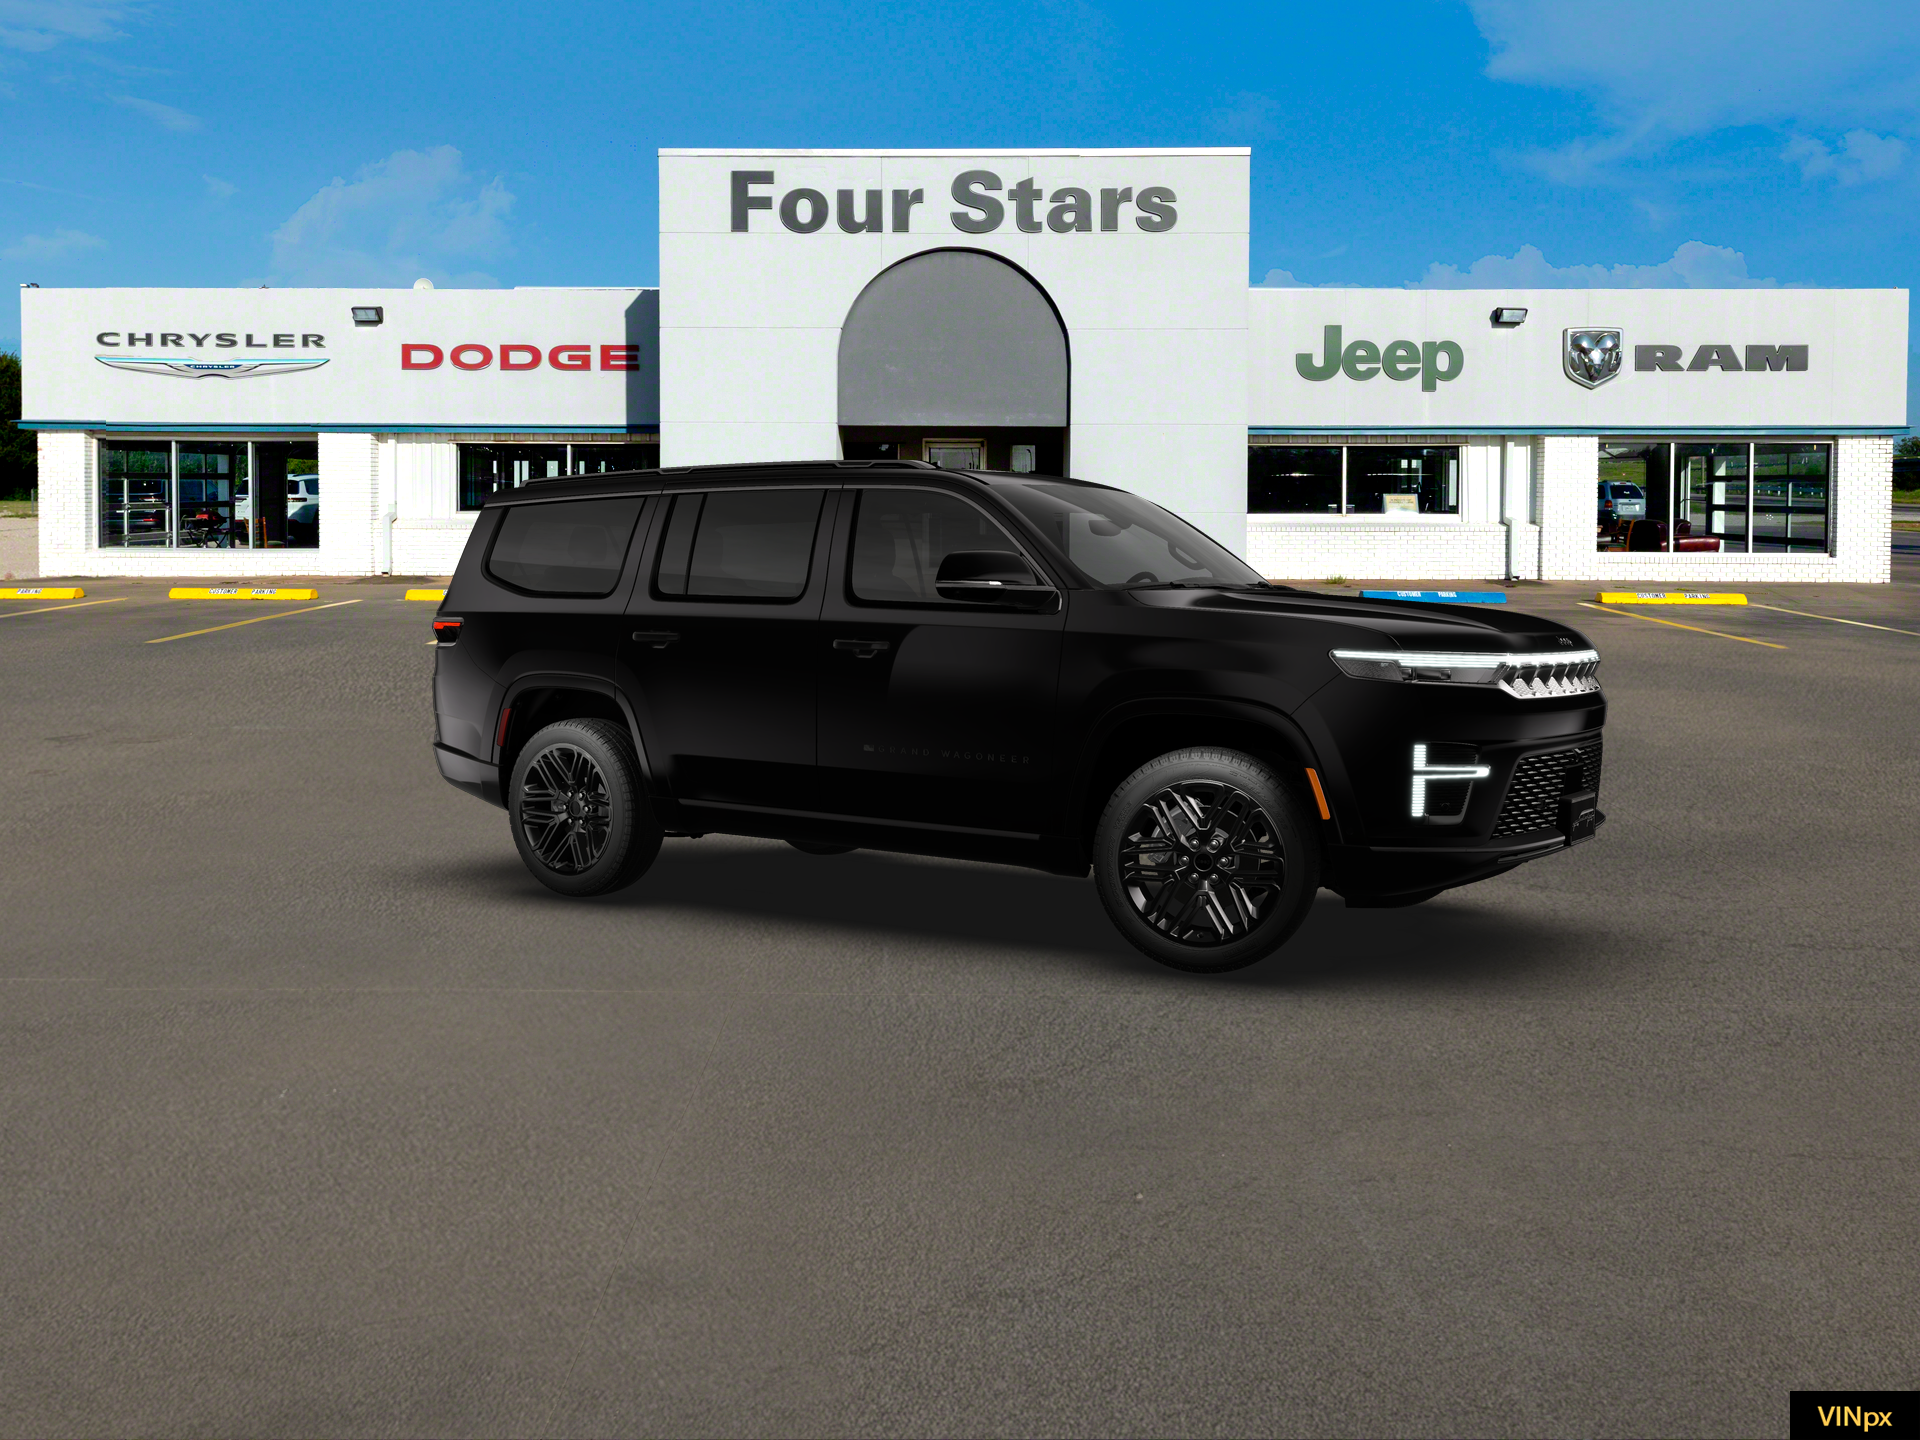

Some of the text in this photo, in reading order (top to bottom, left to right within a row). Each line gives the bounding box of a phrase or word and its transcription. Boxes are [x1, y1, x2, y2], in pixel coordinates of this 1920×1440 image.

[730, 169, 1178, 234] Four Stars
[96, 332, 327, 348] CHRYSLER
[401, 343, 640, 372] DODGE
[1295, 325, 1464, 392] Jeep
[1635, 344, 1809, 372] RAM
[878, 745, 1030, 764] GRAND WAGONEER
